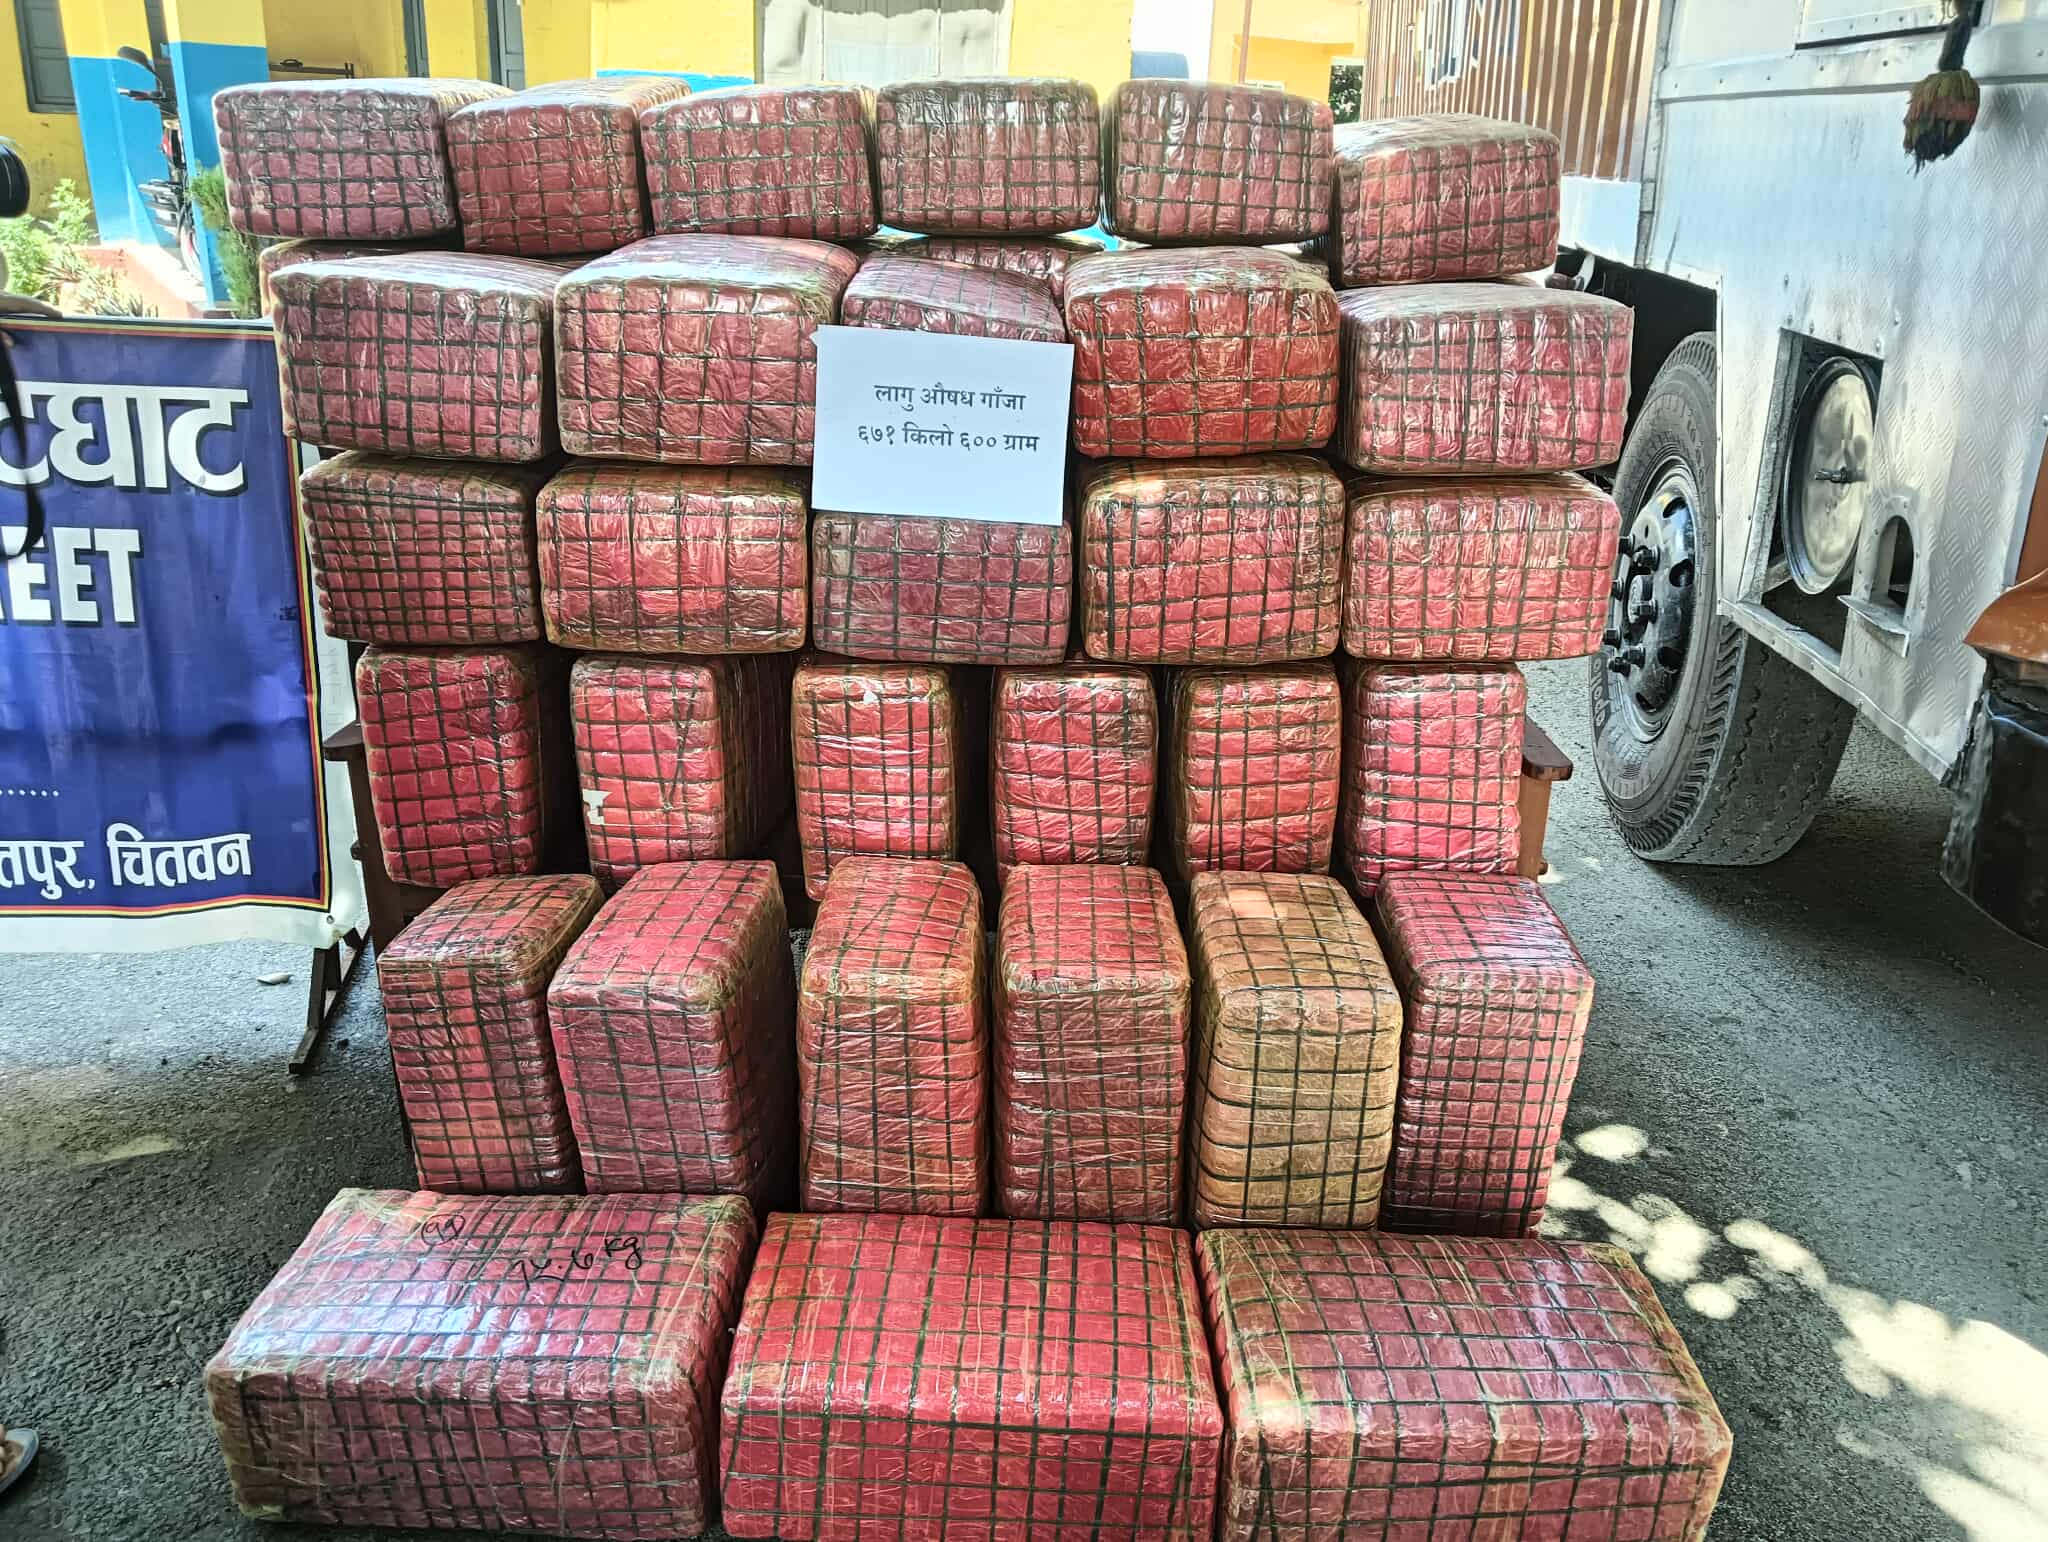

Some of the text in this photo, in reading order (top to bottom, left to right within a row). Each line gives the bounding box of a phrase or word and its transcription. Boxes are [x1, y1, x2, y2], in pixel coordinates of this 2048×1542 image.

[874, 381, 1027, 412] लागु औषध गाँजा
[857, 420, 1041, 453] ६७१ किलो ६०० ग्राम
[0, 525, 140, 622] EET
[106, 822, 252, 887] चितवन
